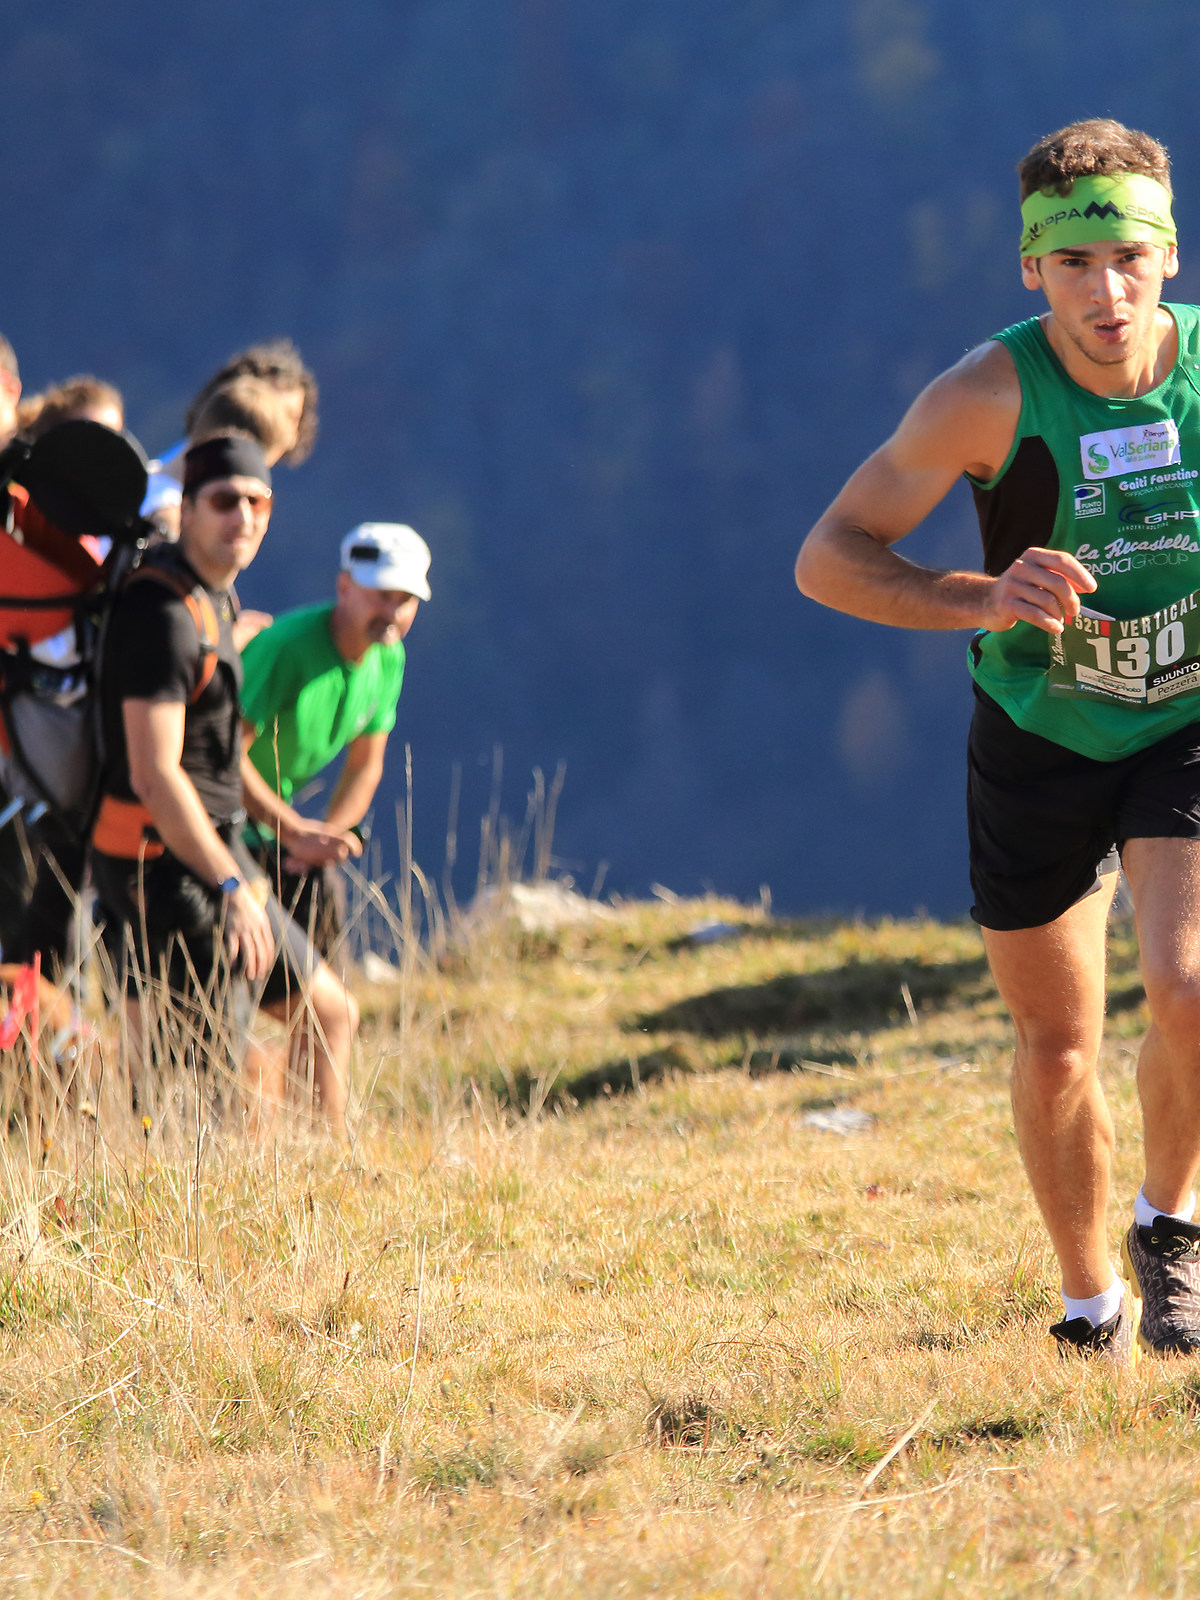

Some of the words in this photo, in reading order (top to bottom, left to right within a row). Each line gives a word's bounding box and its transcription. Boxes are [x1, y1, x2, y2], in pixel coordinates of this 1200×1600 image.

[1110, 439, 1175, 458] ValSeriana
[1118, 477, 1148, 493] Gaiti
[1149, 468, 1199, 485] Faustino
[1081, 501, 1102, 509] PUNTO
[1144, 509, 1200, 525] GHP
[1075, 543, 1100, 561] La
[1105, 534, 1200, 559] Recastello
[1119, 593, 1198, 638] VERTICAL
[1086, 621, 1186, 679] 130
[1152, 662, 1200, 687] SUUNTO
[1157, 674, 1199, 696] Pezzera
